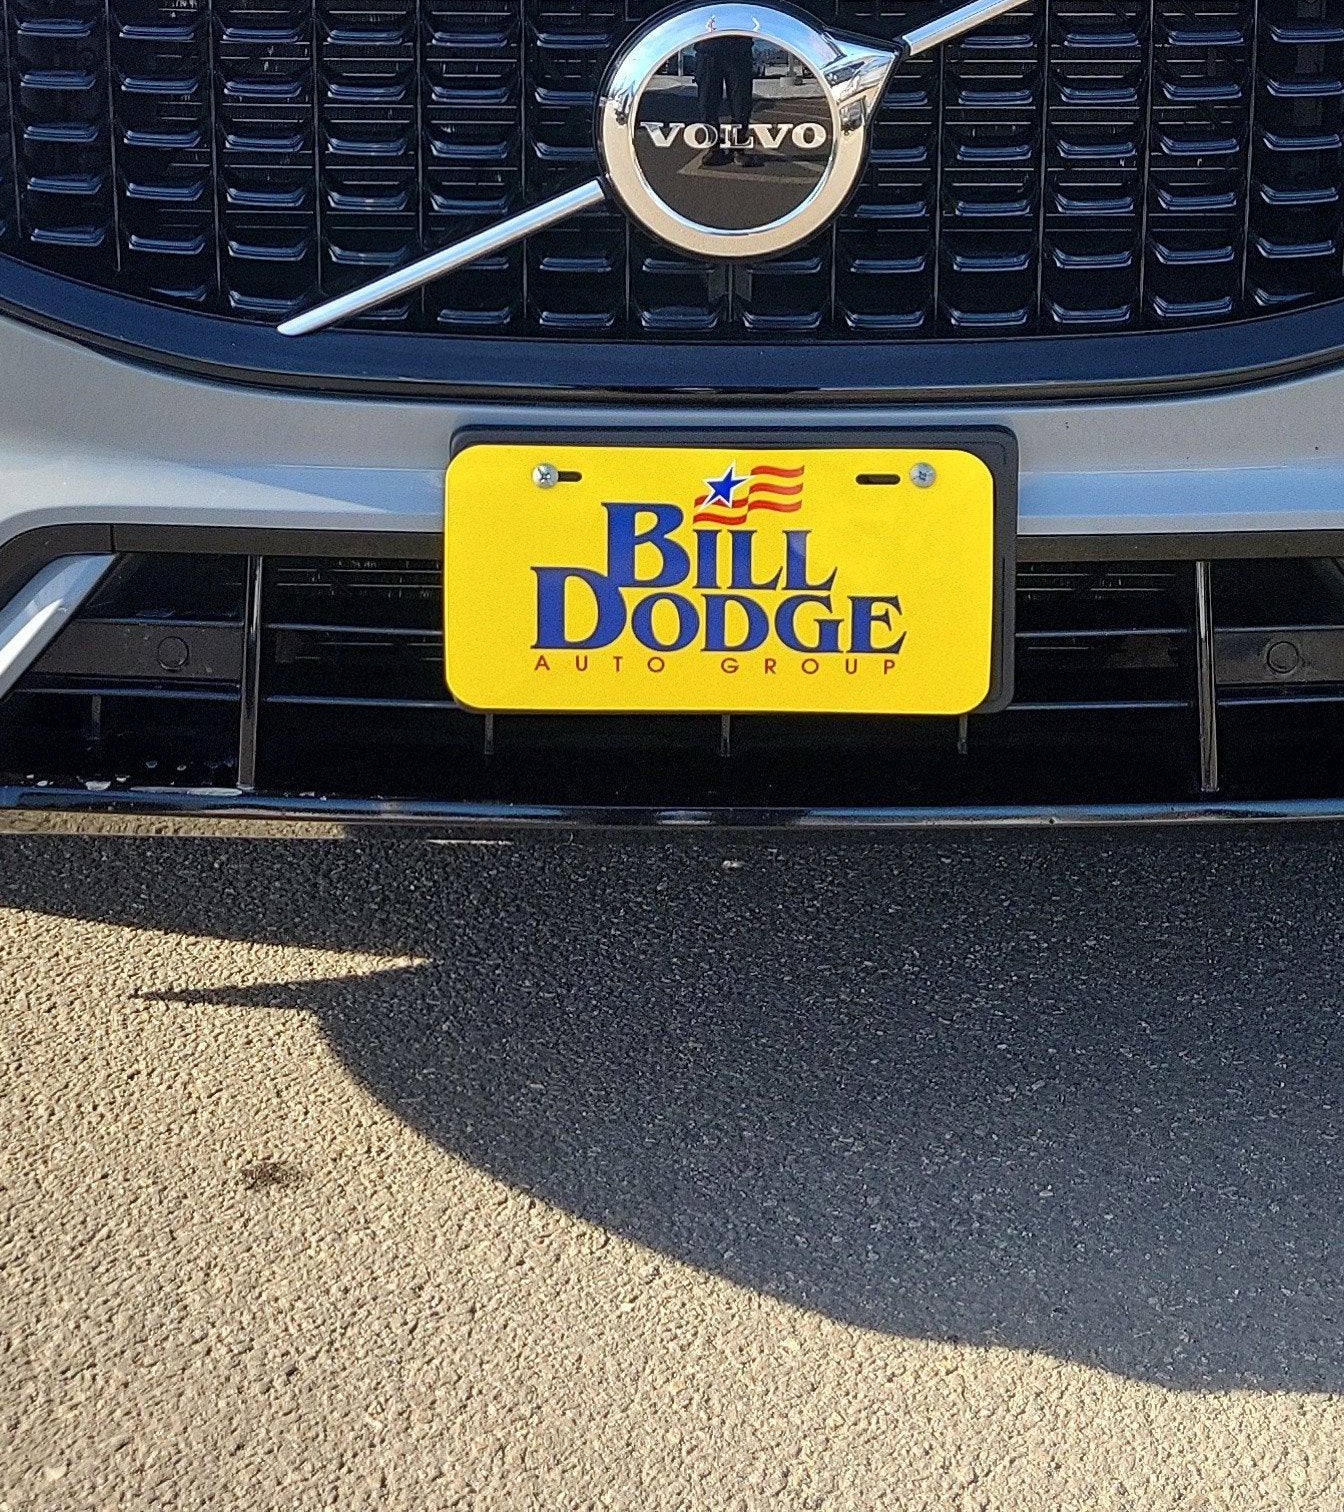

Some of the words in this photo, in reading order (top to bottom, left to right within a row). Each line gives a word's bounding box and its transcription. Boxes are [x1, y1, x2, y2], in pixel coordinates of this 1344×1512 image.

[640, 121, 827, 149] VOLVO
[601, 501, 837, 591] BILL
[530, 565, 907, 656] DODGE
[534, 655, 665, 673] AUTO
[721, 658, 896, 675] GROUP
